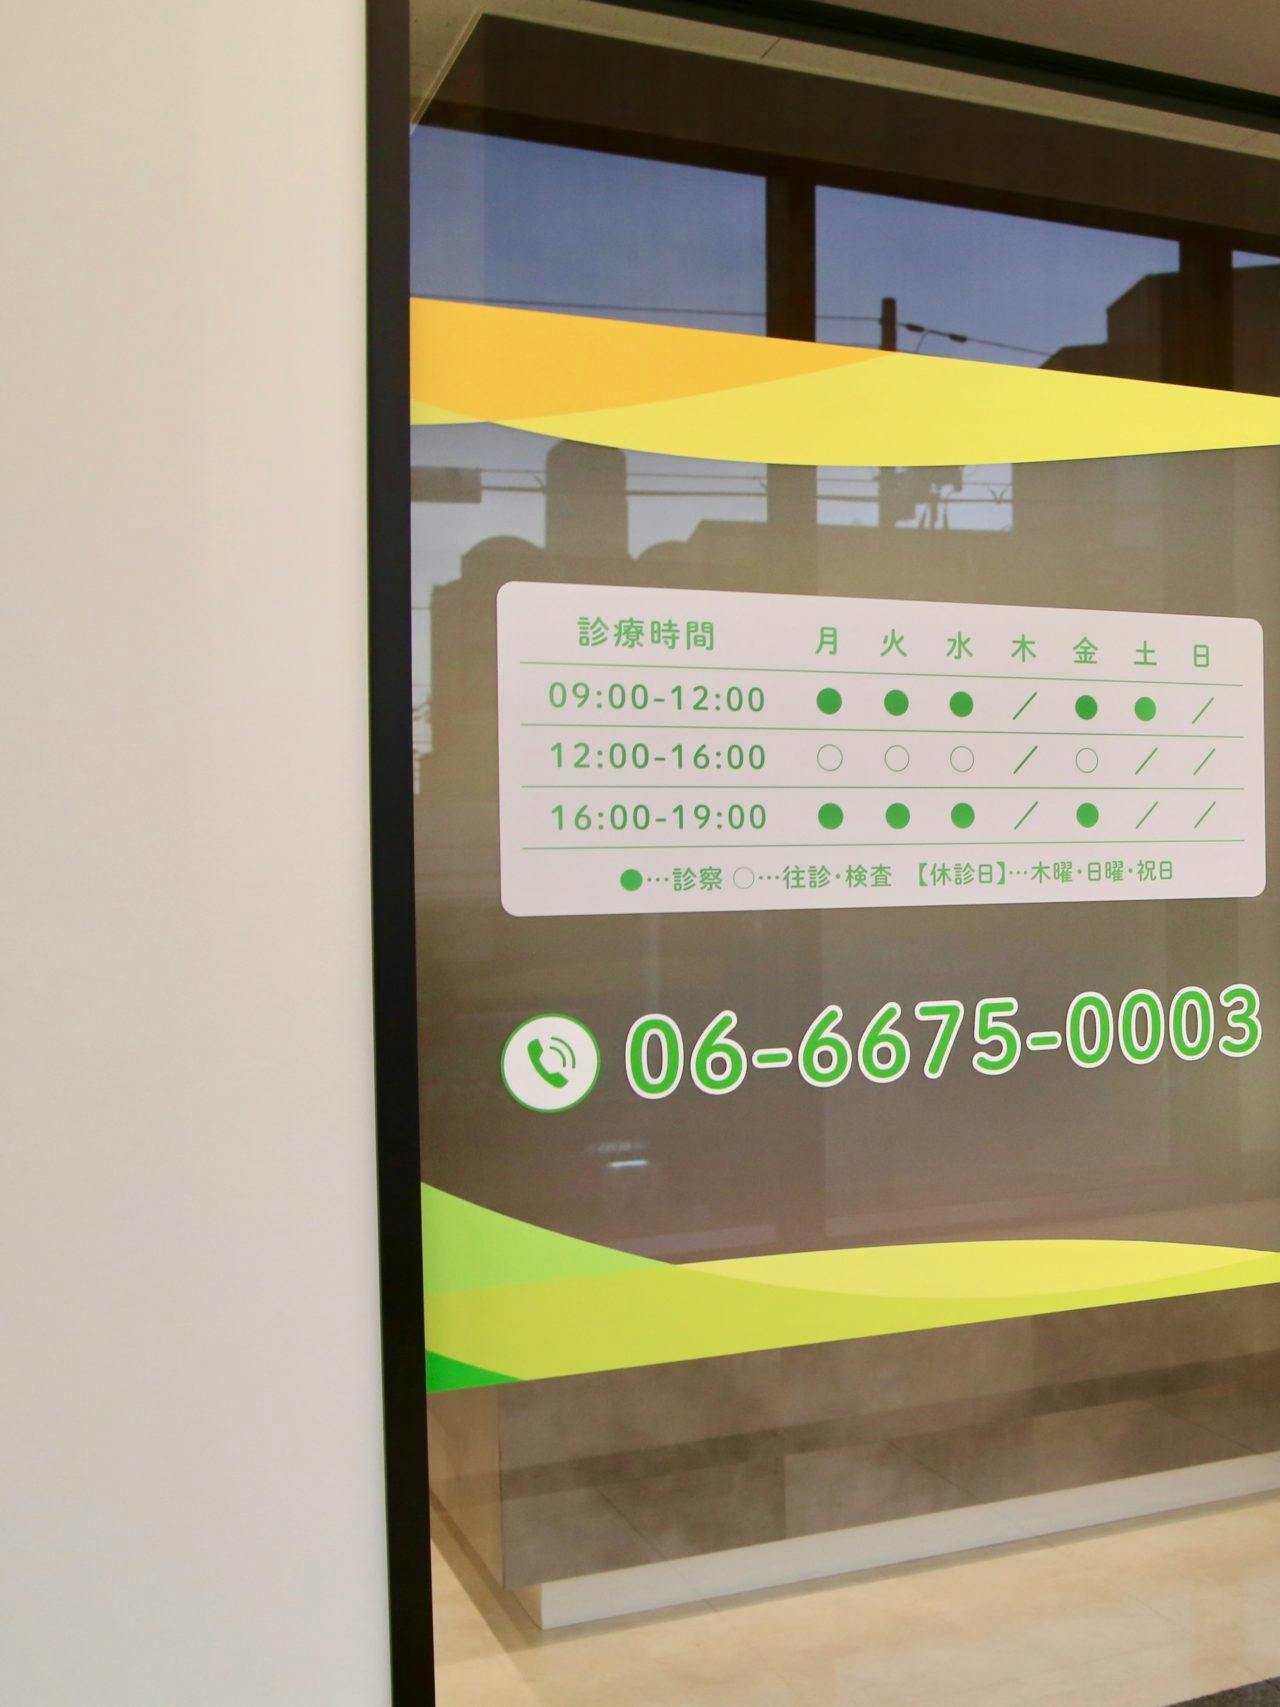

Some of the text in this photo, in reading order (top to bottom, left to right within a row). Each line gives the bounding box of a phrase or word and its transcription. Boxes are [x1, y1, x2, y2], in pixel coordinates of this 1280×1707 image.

[577, 616, 1211, 668] 診療時間 月 火 水 木 金 土 日
[547, 681, 767, 713] 09:00-12:00
[549, 741, 767, 770] 12:00-16:00
[550, 803, 768, 831] 16:00-19:00
[625, 983, 1263, 1100] 06-6675-0003
